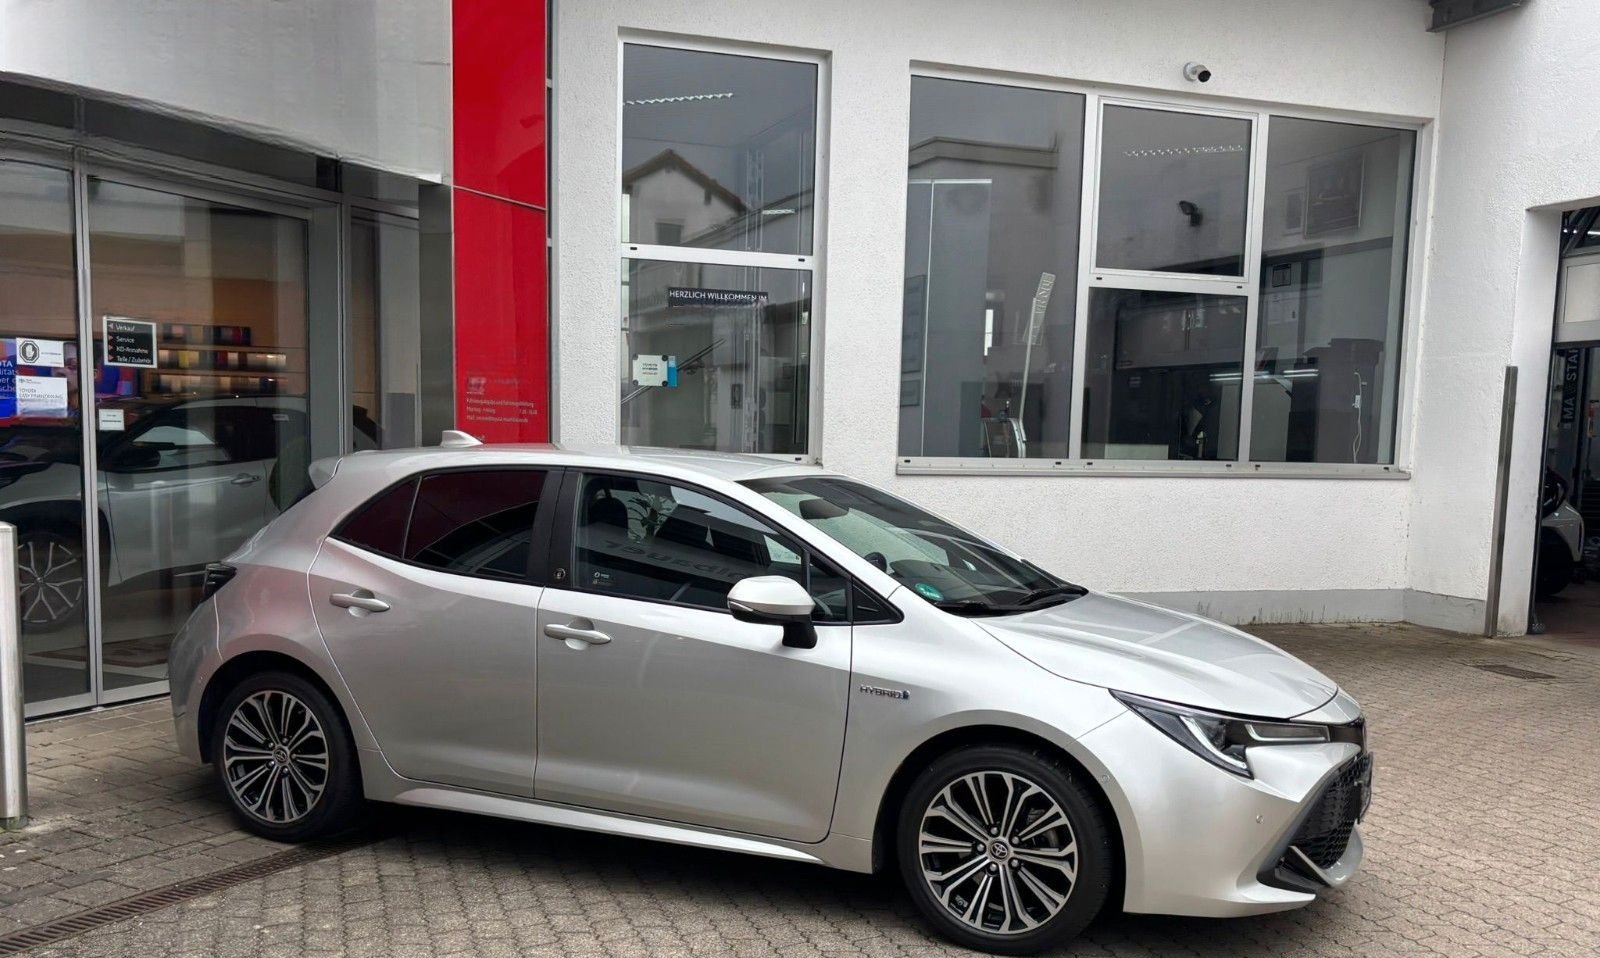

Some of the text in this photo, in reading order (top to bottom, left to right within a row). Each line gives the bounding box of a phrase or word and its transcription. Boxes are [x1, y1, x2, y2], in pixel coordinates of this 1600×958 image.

[669, 290, 706, 299] HERZLICH
[116, 323, 136, 332] Verkauf
[116, 335, 135, 343] Service
[860, 684, 903, 699] HYBRID
